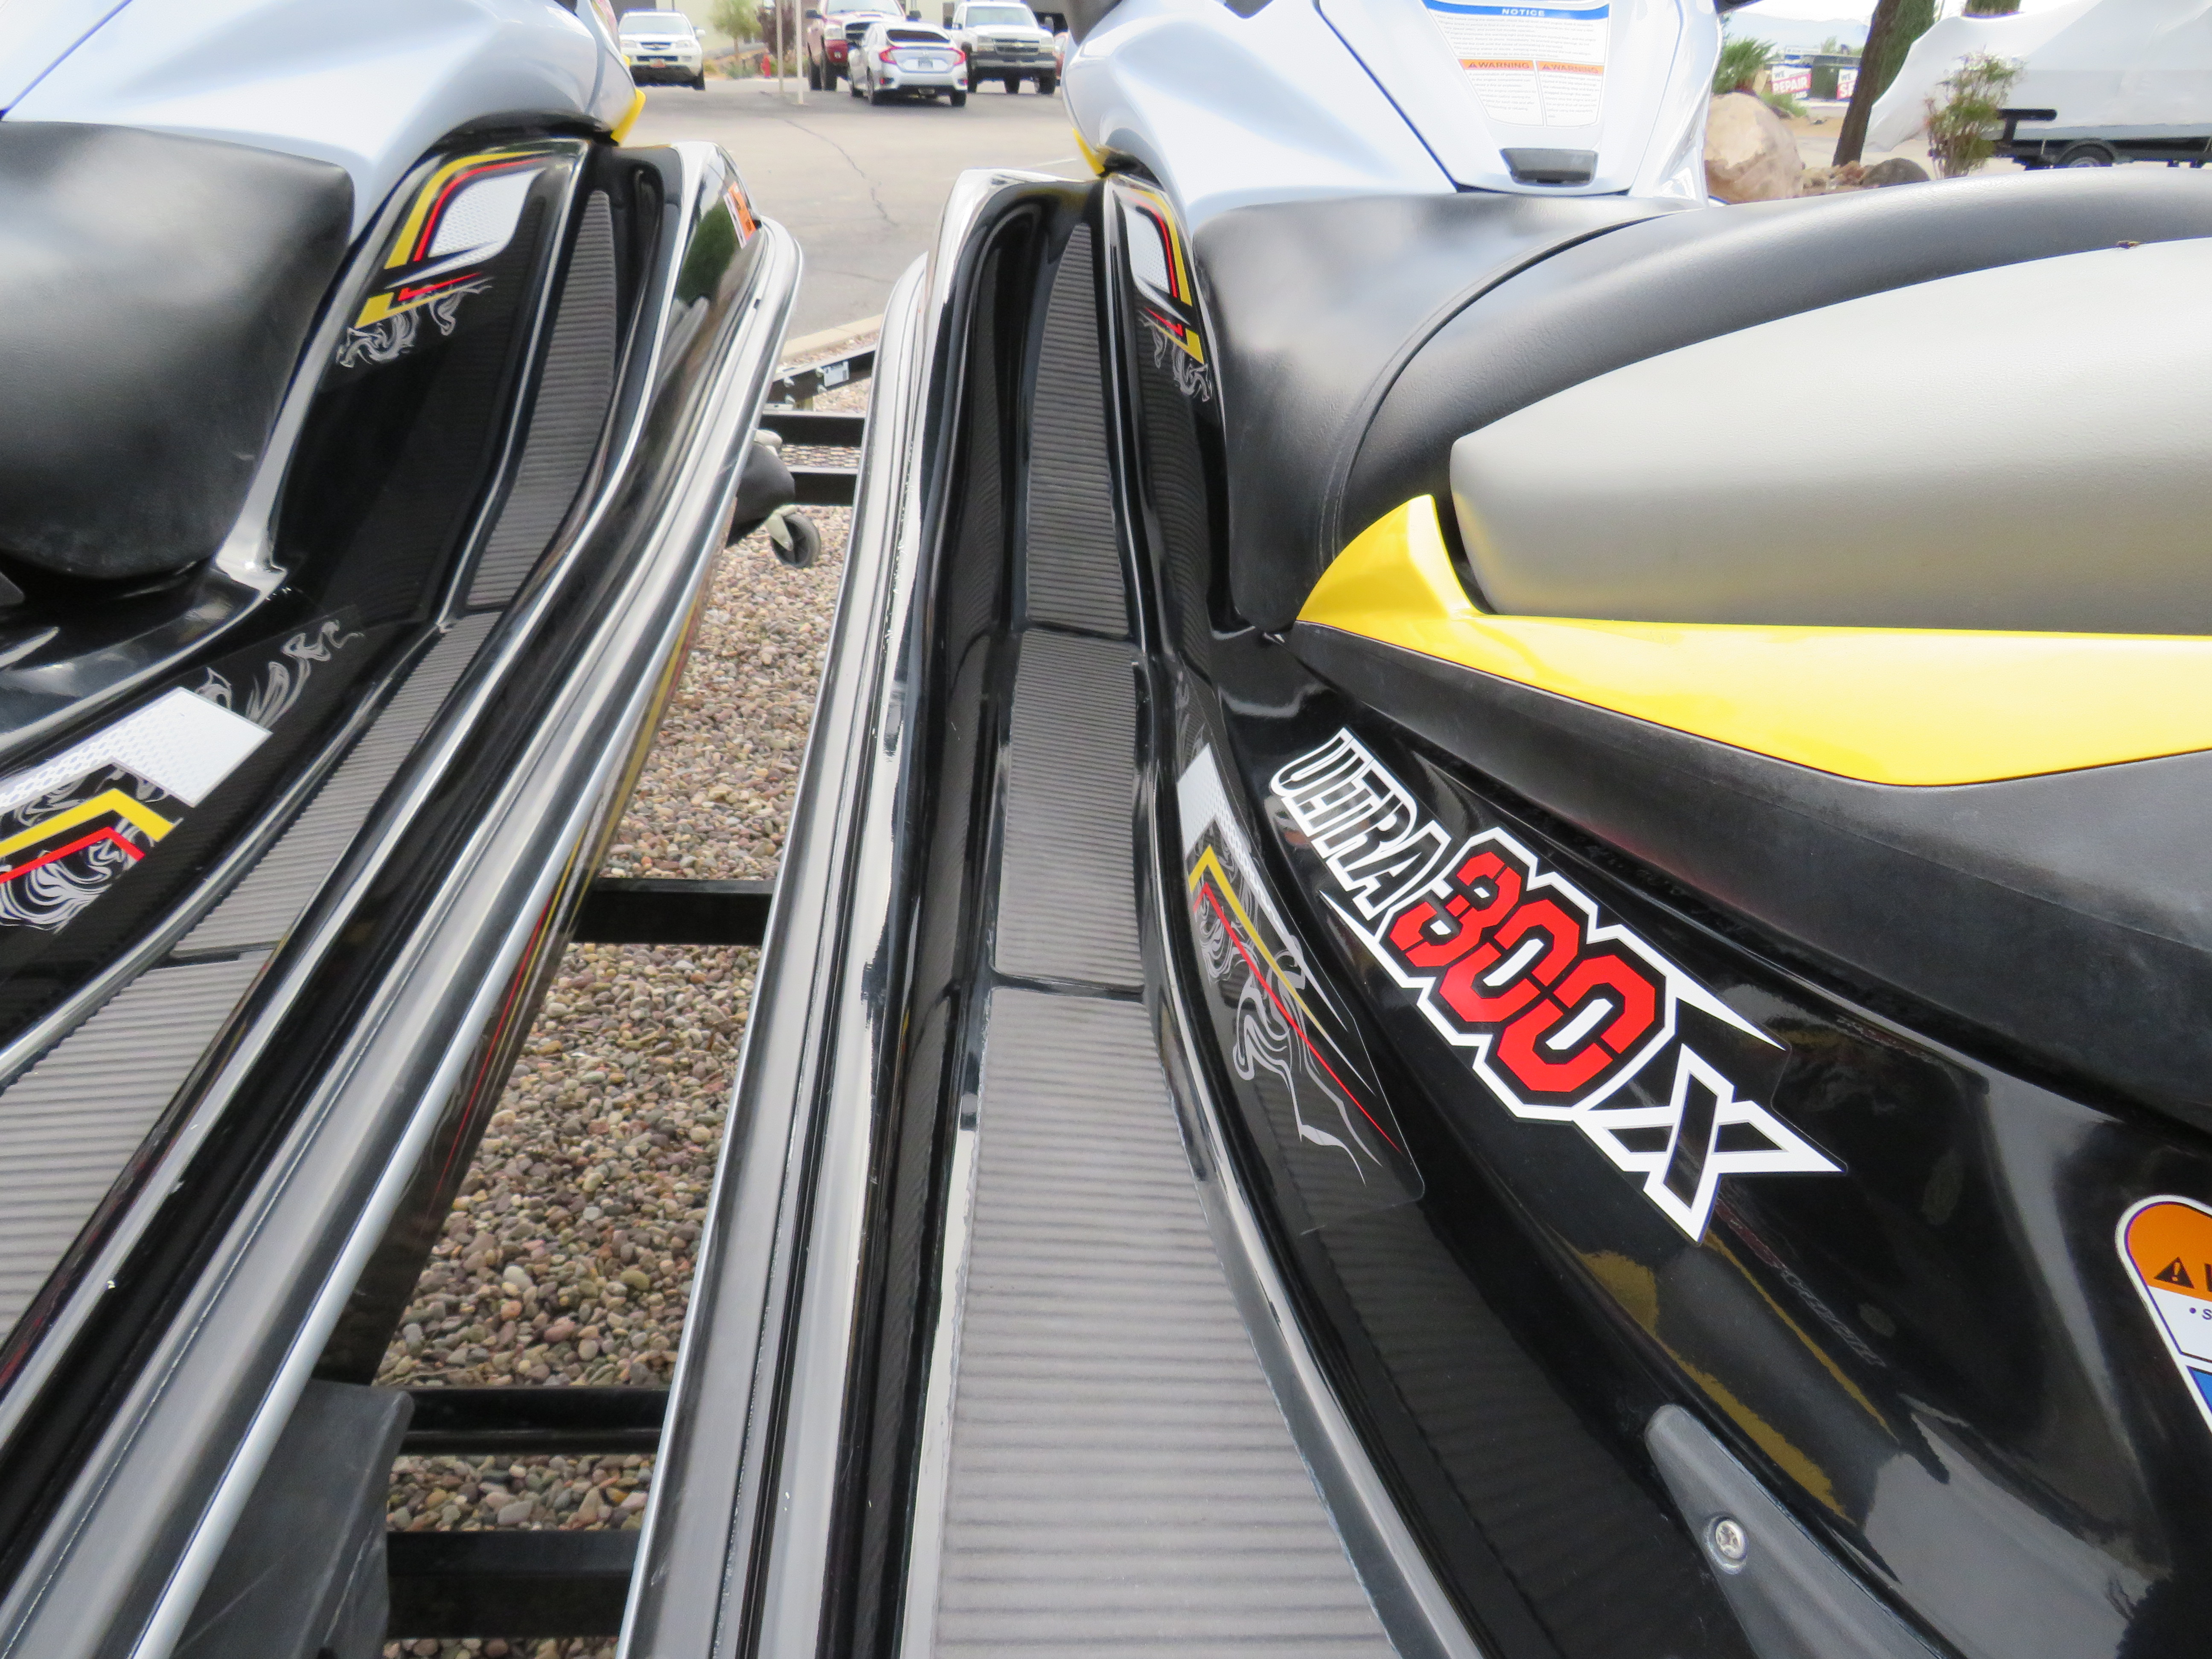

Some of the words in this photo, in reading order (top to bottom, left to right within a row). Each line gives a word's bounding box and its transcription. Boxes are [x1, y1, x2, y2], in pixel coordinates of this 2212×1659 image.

[1502, 9, 1545, 17] NOTICE
[1551, 64, 1598, 73] WARNING
[1773, 76, 1807, 93] REPAIR
[1269, 727, 1452, 921] ULTRA
